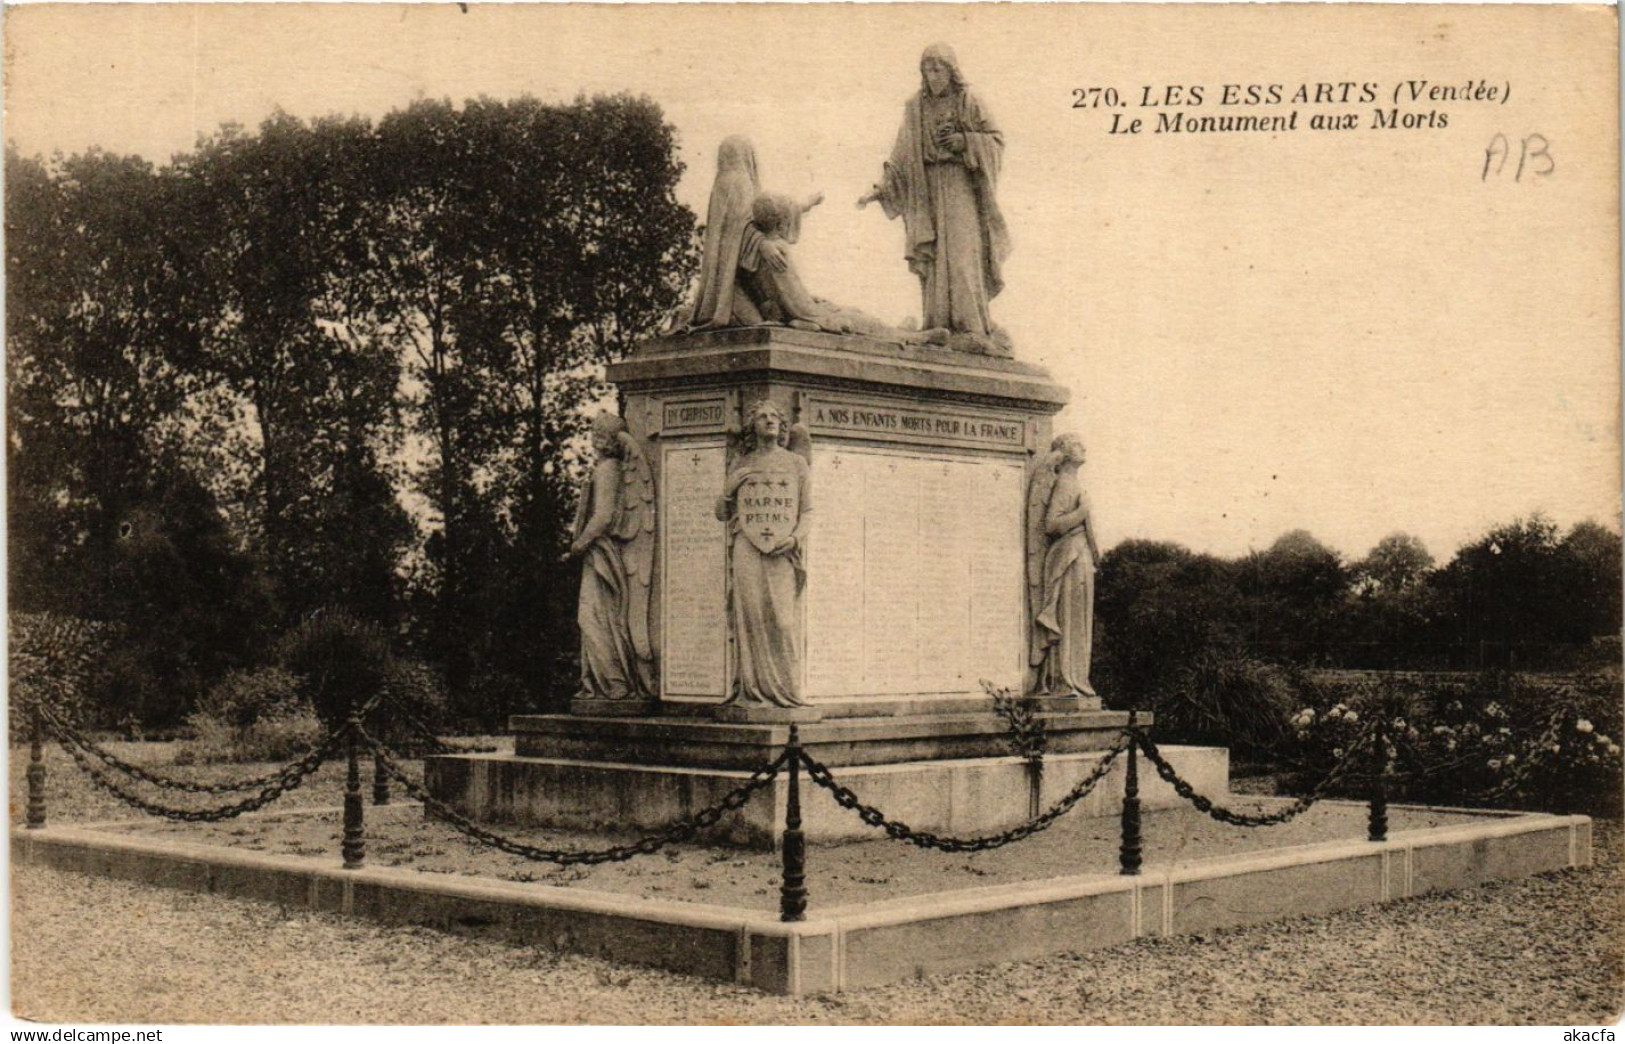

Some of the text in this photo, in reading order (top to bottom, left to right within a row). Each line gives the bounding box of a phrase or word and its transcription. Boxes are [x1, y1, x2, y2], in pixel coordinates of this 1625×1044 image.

[816, 409, 1018, 440] A NOS ENFANTS MORTS POUR LA FRANCE
[743, 497, 793, 508] MARNE
